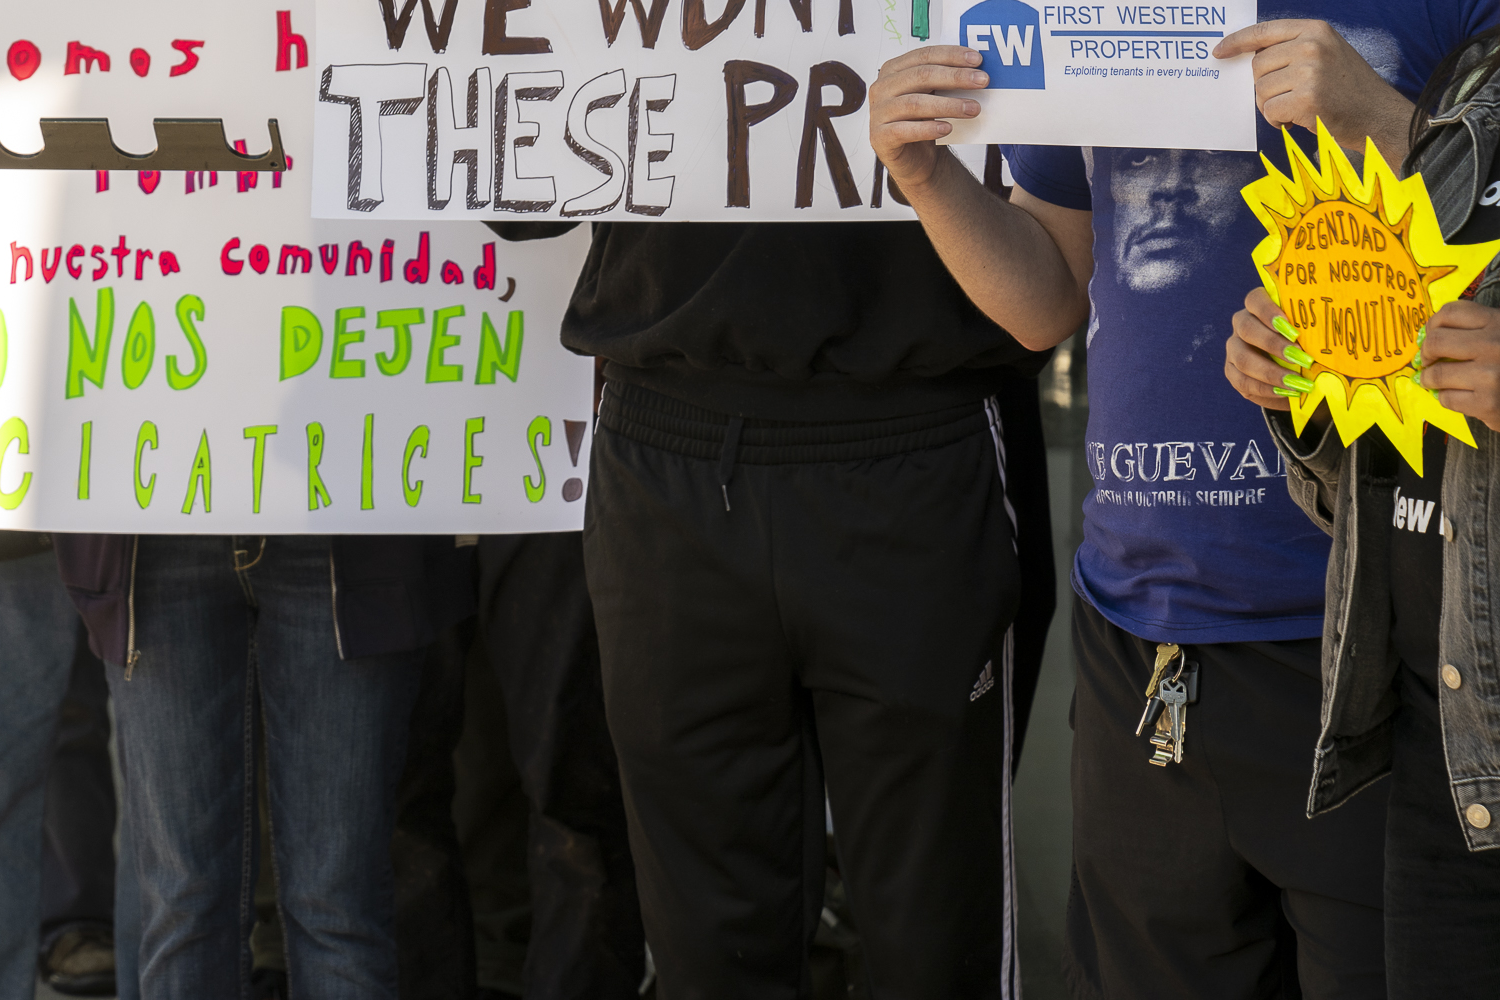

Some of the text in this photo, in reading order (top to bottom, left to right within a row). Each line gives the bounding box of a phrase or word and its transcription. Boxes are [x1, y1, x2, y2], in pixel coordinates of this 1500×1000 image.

[1043, 5, 1227, 26] FIRST WESTERN
[966, 24, 1035, 67] FW
[1070, 39, 1209, 60] PROPERTIES
[1063, 65, 1220, 80] Exploiting tenants in every building
[317, 61, 678, 219] THESE
[1294, 210, 1387, 252] DIGNIDAD
[219, 231, 517, 303] comunidad,
[1285, 259, 1417, 300] POR NOSOTROS
[64, 285, 208, 400] NOS
[278, 304, 526, 386] DEJEN
[1289, 294, 1427, 362] LOS INQUILINOS
[1195, 487, 1267, 507] SIEMPRE
